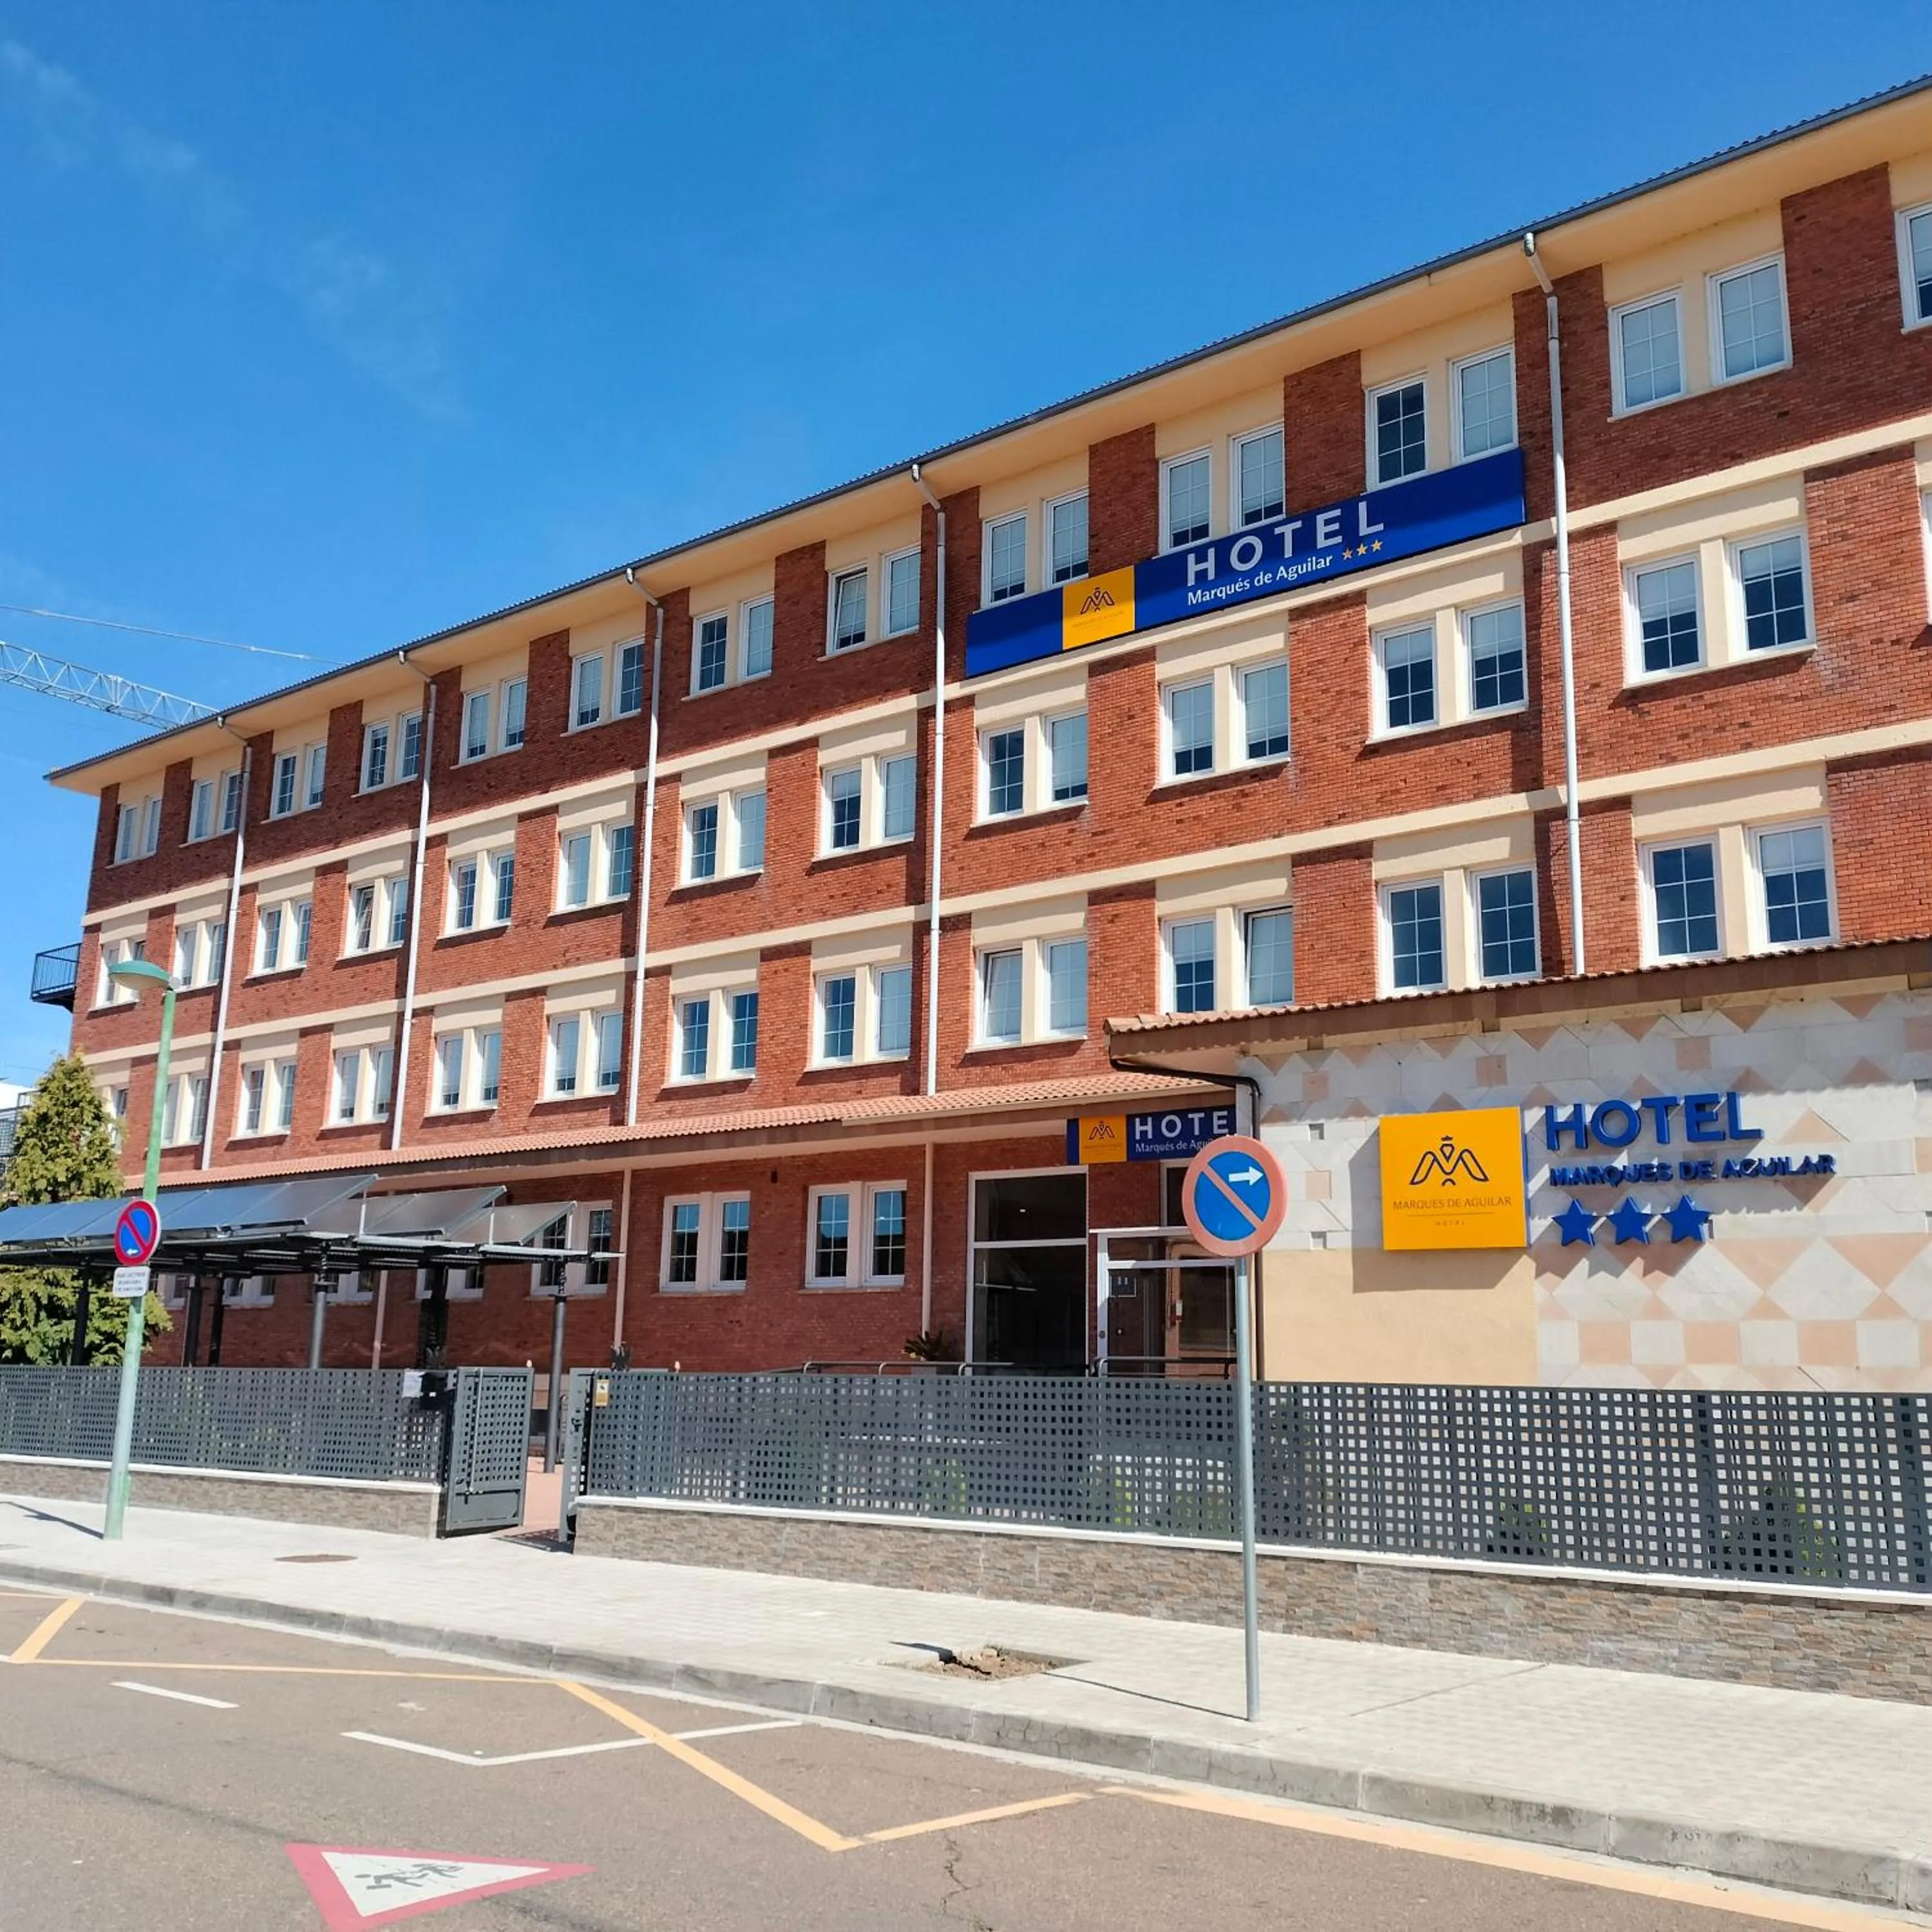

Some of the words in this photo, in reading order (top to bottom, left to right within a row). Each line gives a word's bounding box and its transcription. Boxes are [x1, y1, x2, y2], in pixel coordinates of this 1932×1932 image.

[1187, 501, 1384, 587] HOTEL
[1188, 577, 1250, 605] Marqués
[1254, 571, 1273, 587] de
[1276, 555, 1332, 580] Aguilar
[1135, 1110, 1229, 1141] HOTE
[1546, 1092, 1763, 1150] HOTEL
[1135, 1141, 1174, 1153] Marqués
[1549, 1163, 1673, 1187] MARQUES
[1679, 1160, 1716, 1181] DE
[1721, 1153, 1835, 1179] AGUILAR
[1393, 1199, 1444, 1209] MARQUES
[1447, 1198, 1462, 1208] DE
[1464, 1196, 1511, 1207] AGUILAR
